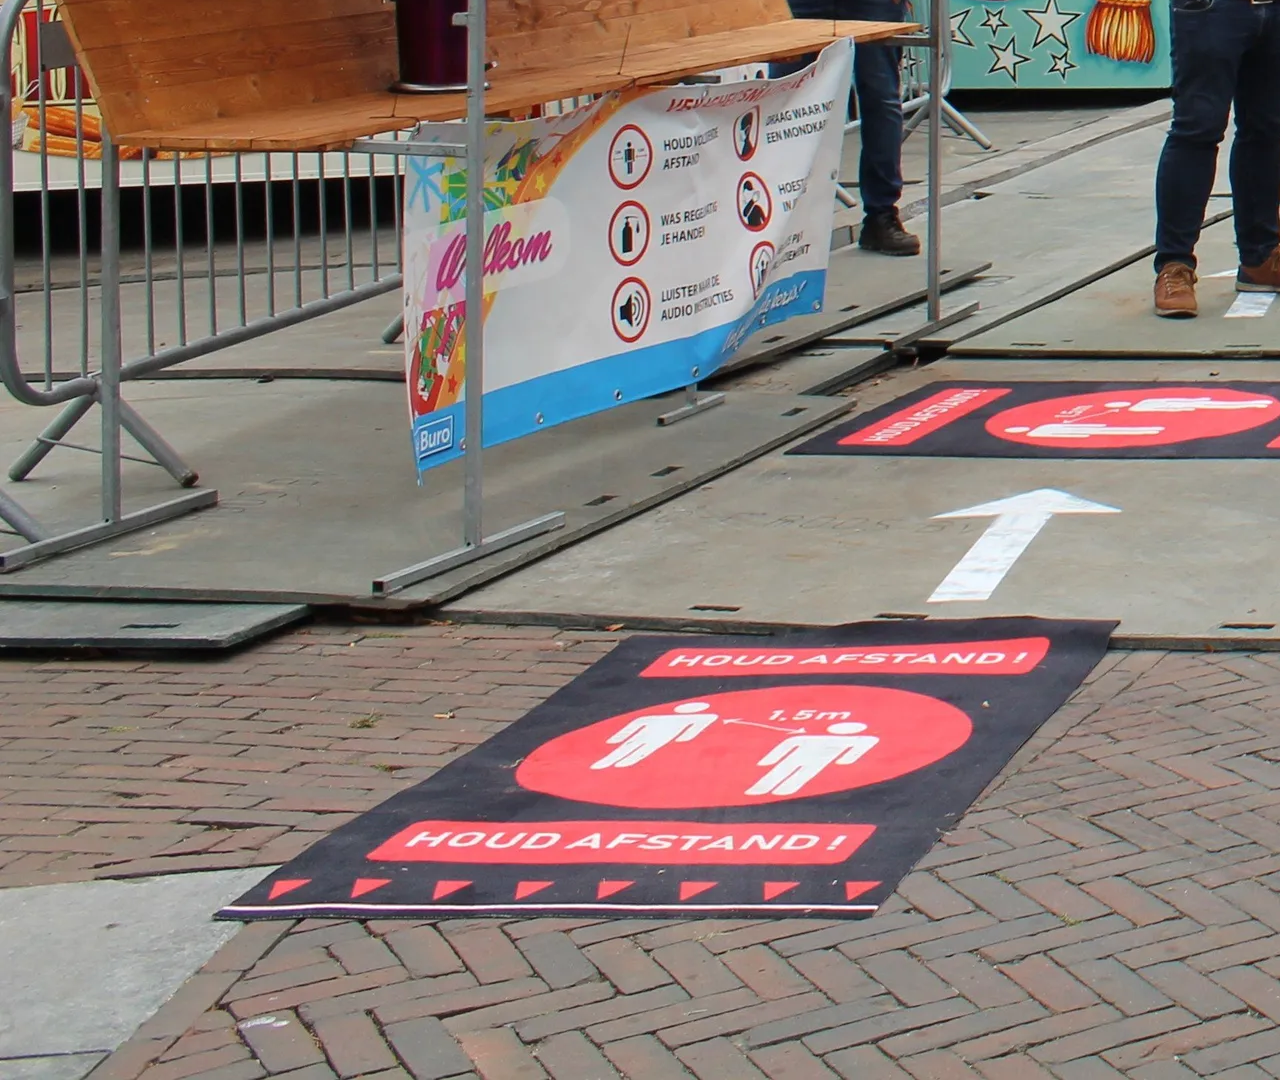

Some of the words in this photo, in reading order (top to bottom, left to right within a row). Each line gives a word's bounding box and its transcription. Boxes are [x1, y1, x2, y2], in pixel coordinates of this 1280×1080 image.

[793, 104, 821, 120] WAAR
[664, 136, 693, 152] HOUD
[766, 129, 782, 144] EEN
[663, 153, 700, 170] AFSTAND
[661, 212, 681, 227] WAS
[660, 232, 671, 246] JE
[436, 220, 552, 292] Wlkom
[661, 282, 699, 303] LUISTER
[660, 304, 694, 322] AUDIO
[420, 427, 451, 451] Buro
[668, 653, 795, 668] HOUD
[405, 831, 562, 850] HOUD
